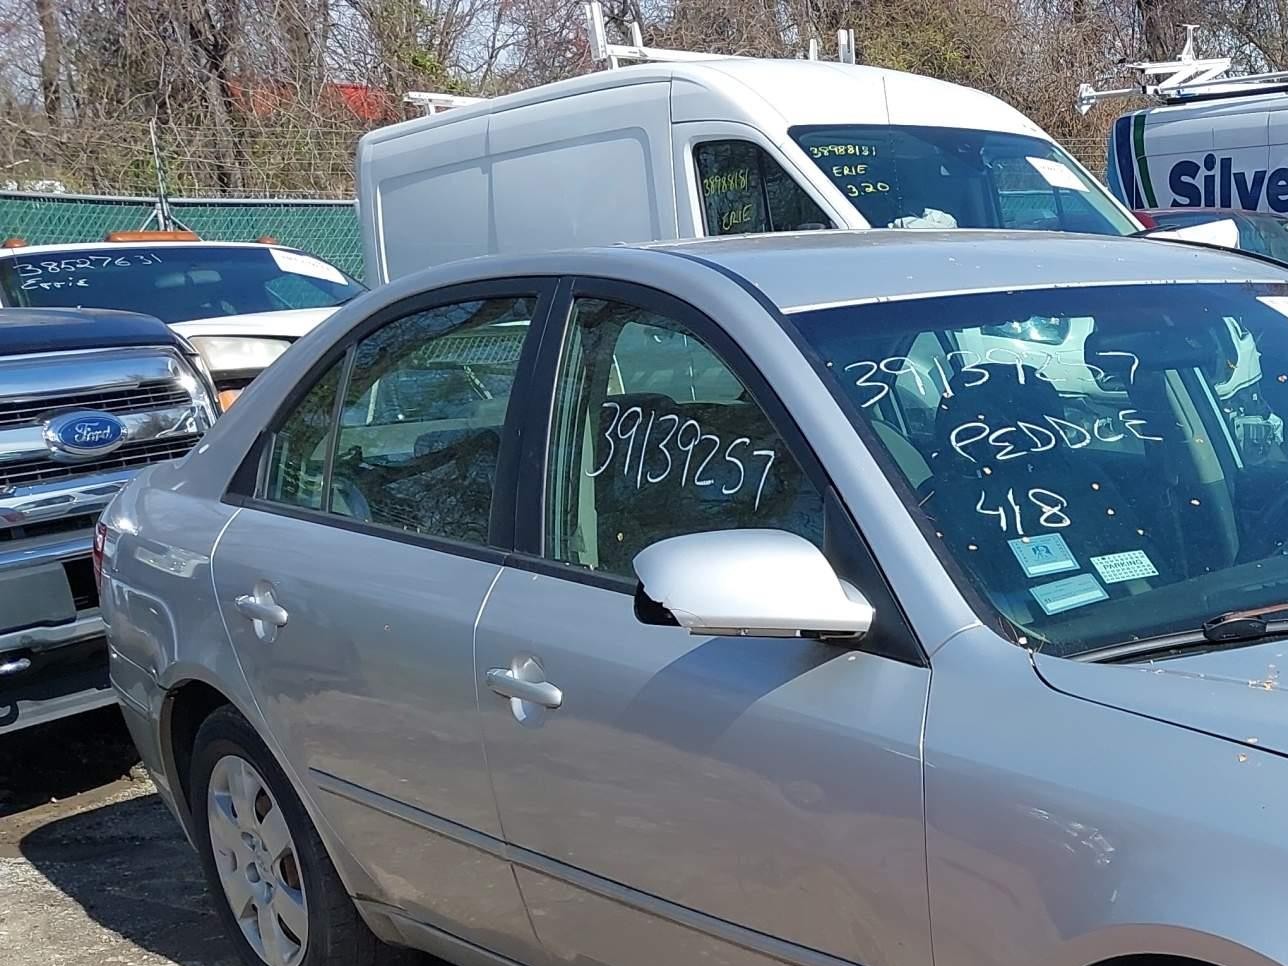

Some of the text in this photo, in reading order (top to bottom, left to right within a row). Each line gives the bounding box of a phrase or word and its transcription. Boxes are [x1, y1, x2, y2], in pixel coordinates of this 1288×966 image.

[832, 164, 868, 177] ERIE
[722, 204, 753, 231] ERIE
[13, 253, 163, 276] 38527631
[75, 422, 112, 442] Ford
[585, 402, 775, 512] 39139257
[1103, 559, 1144, 570] PARKING
